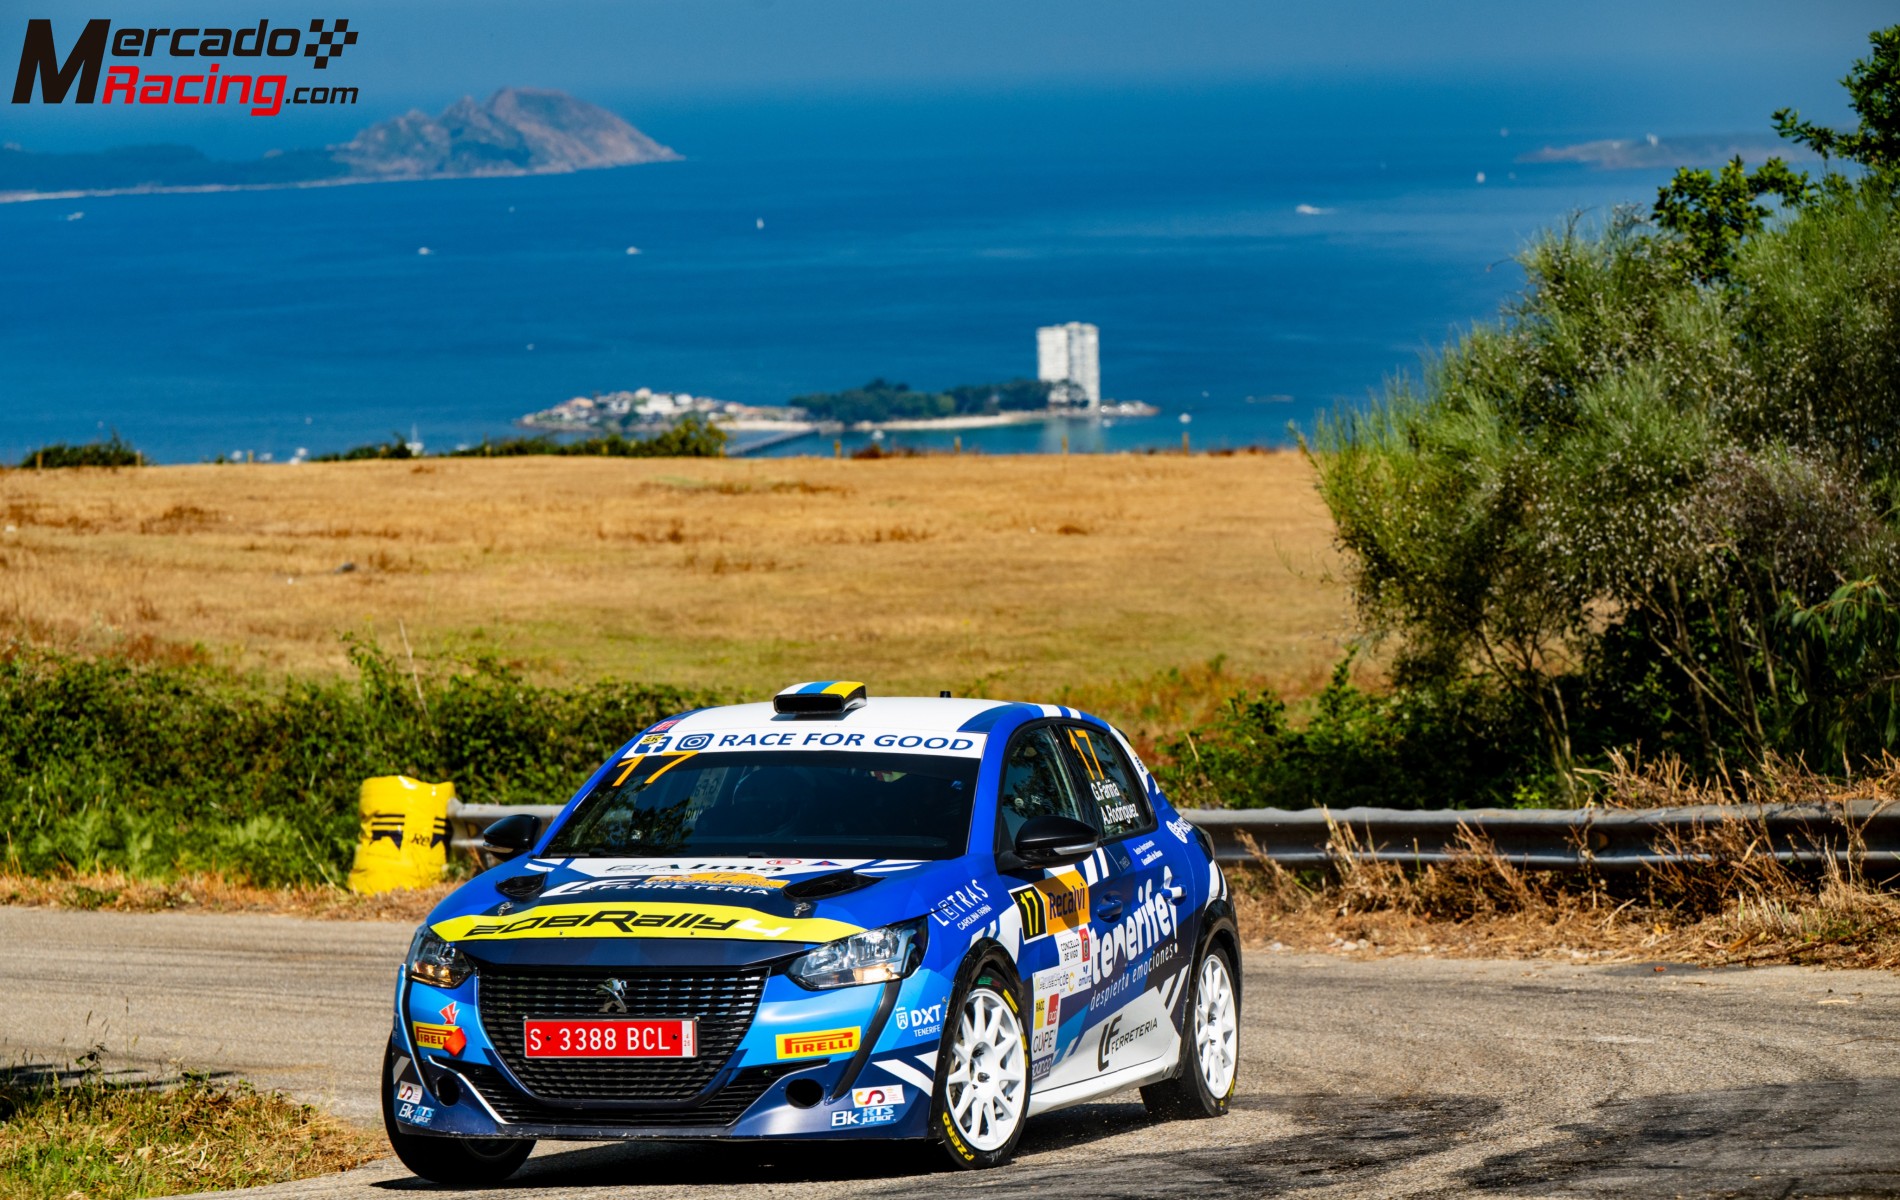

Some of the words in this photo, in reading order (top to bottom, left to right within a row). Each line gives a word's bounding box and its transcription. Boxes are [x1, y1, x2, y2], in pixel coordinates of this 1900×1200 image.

[718, 733, 796, 747] RACE
[802, 733, 865, 747] FOR
[873, 735, 974, 750] GOOD
[1068, 729, 1105, 780] 17
[611, 749, 699, 787] 17
[600, 884, 769, 896] FERRETERIA
[930, 879, 989, 926] LETRAS
[1020, 890, 1039, 936] 17
[1047, 882, 1086, 920] Recalvi
[1090, 971, 1130, 1012] despierta
[1132, 943, 1174, 984] emociones
[910, 1004, 941, 1027] DXT
[530, 1028, 542, 1051] S
[558, 1028, 617, 1051] 3388
[626, 1027, 671, 1051] BCL
[914, 1024, 940, 1037] TENERIFE
[1111, 1017, 1158, 1055] FERRETERIA
[783, 1031, 854, 1054] PIRELLI
[860, 1113, 895, 1125] junior
[863, 1104, 894, 1117] RTS
